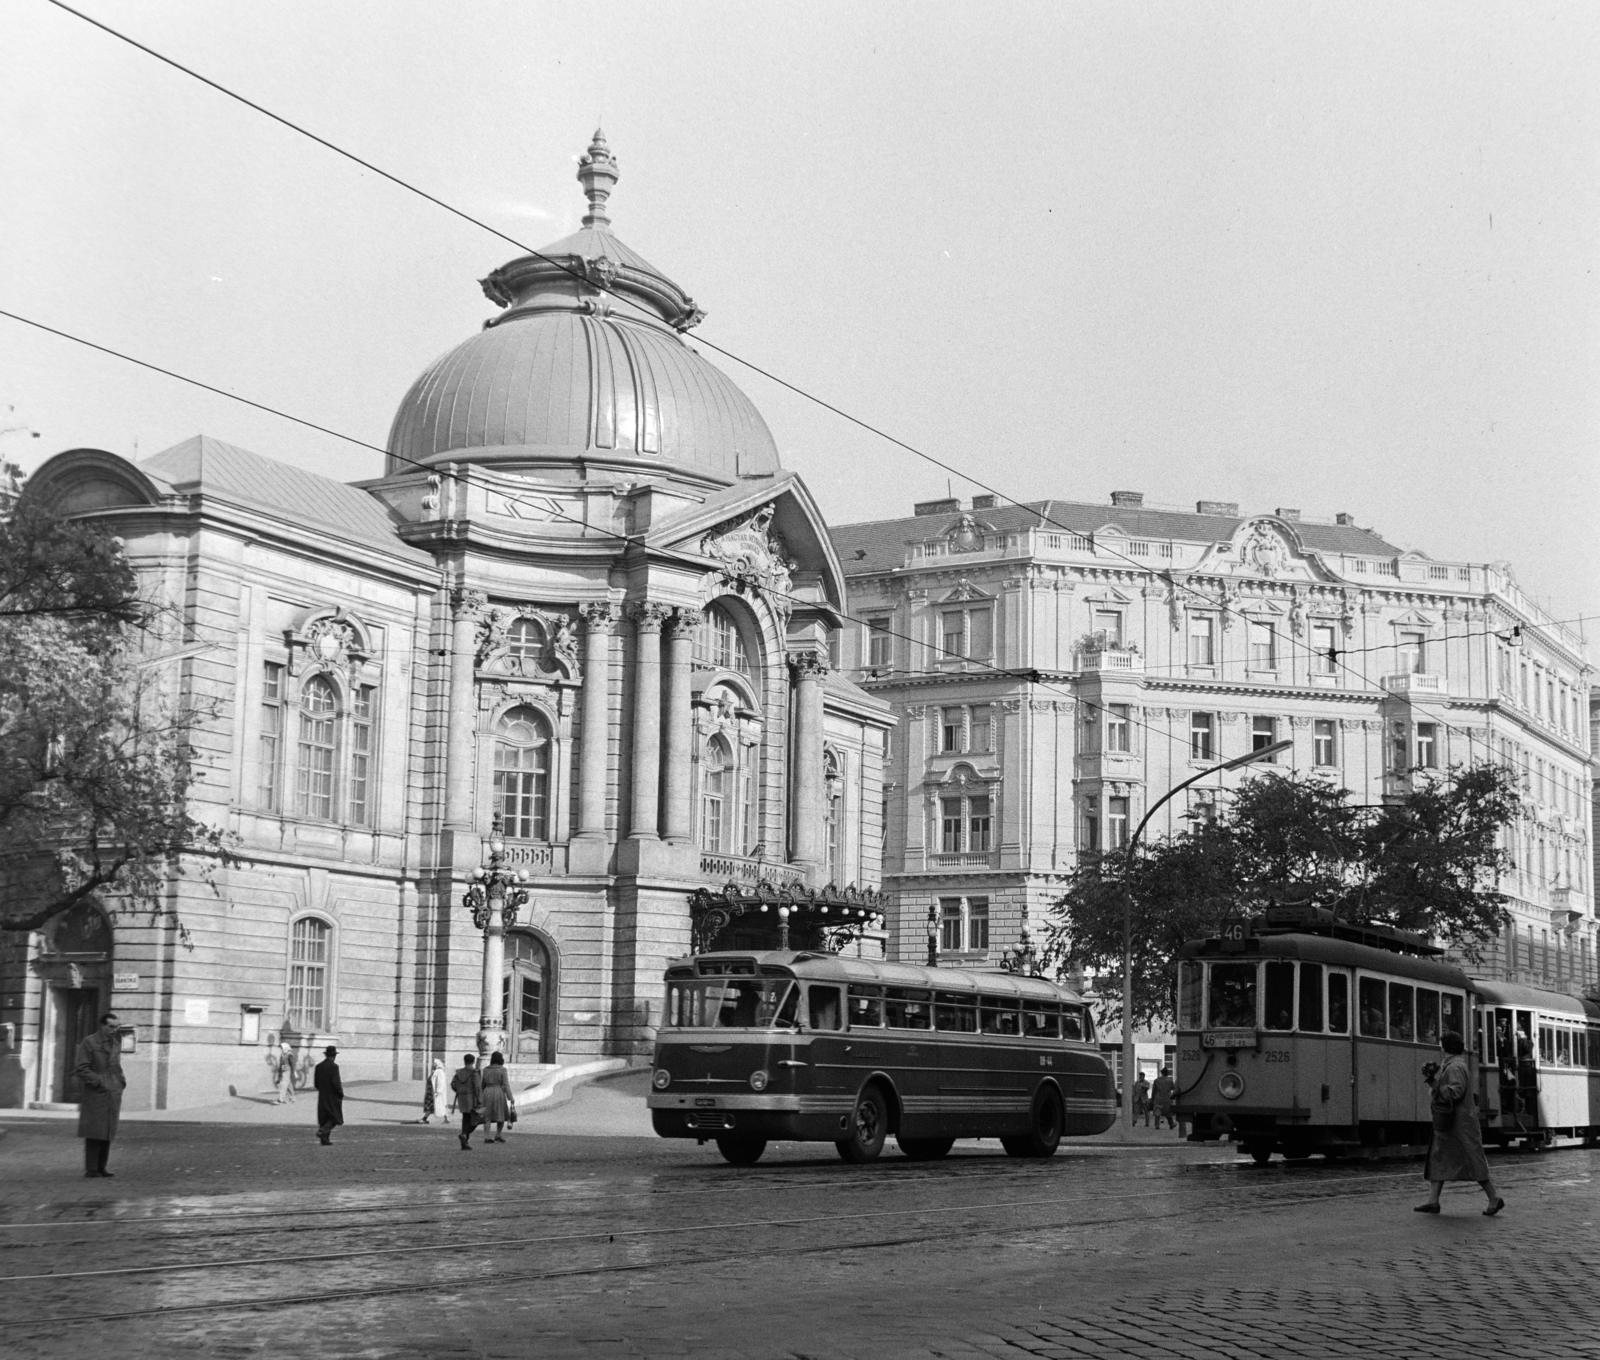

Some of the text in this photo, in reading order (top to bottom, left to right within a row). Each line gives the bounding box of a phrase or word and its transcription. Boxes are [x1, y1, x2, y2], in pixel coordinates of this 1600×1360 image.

[1224, 924, 1243, 941] 46
[721, 962, 733, 974] 12
[1204, 1034, 1215, 1046] 46
[1182, 1049, 1201, 1061] 2526
[1265, 1051, 1290, 1063] 2526
